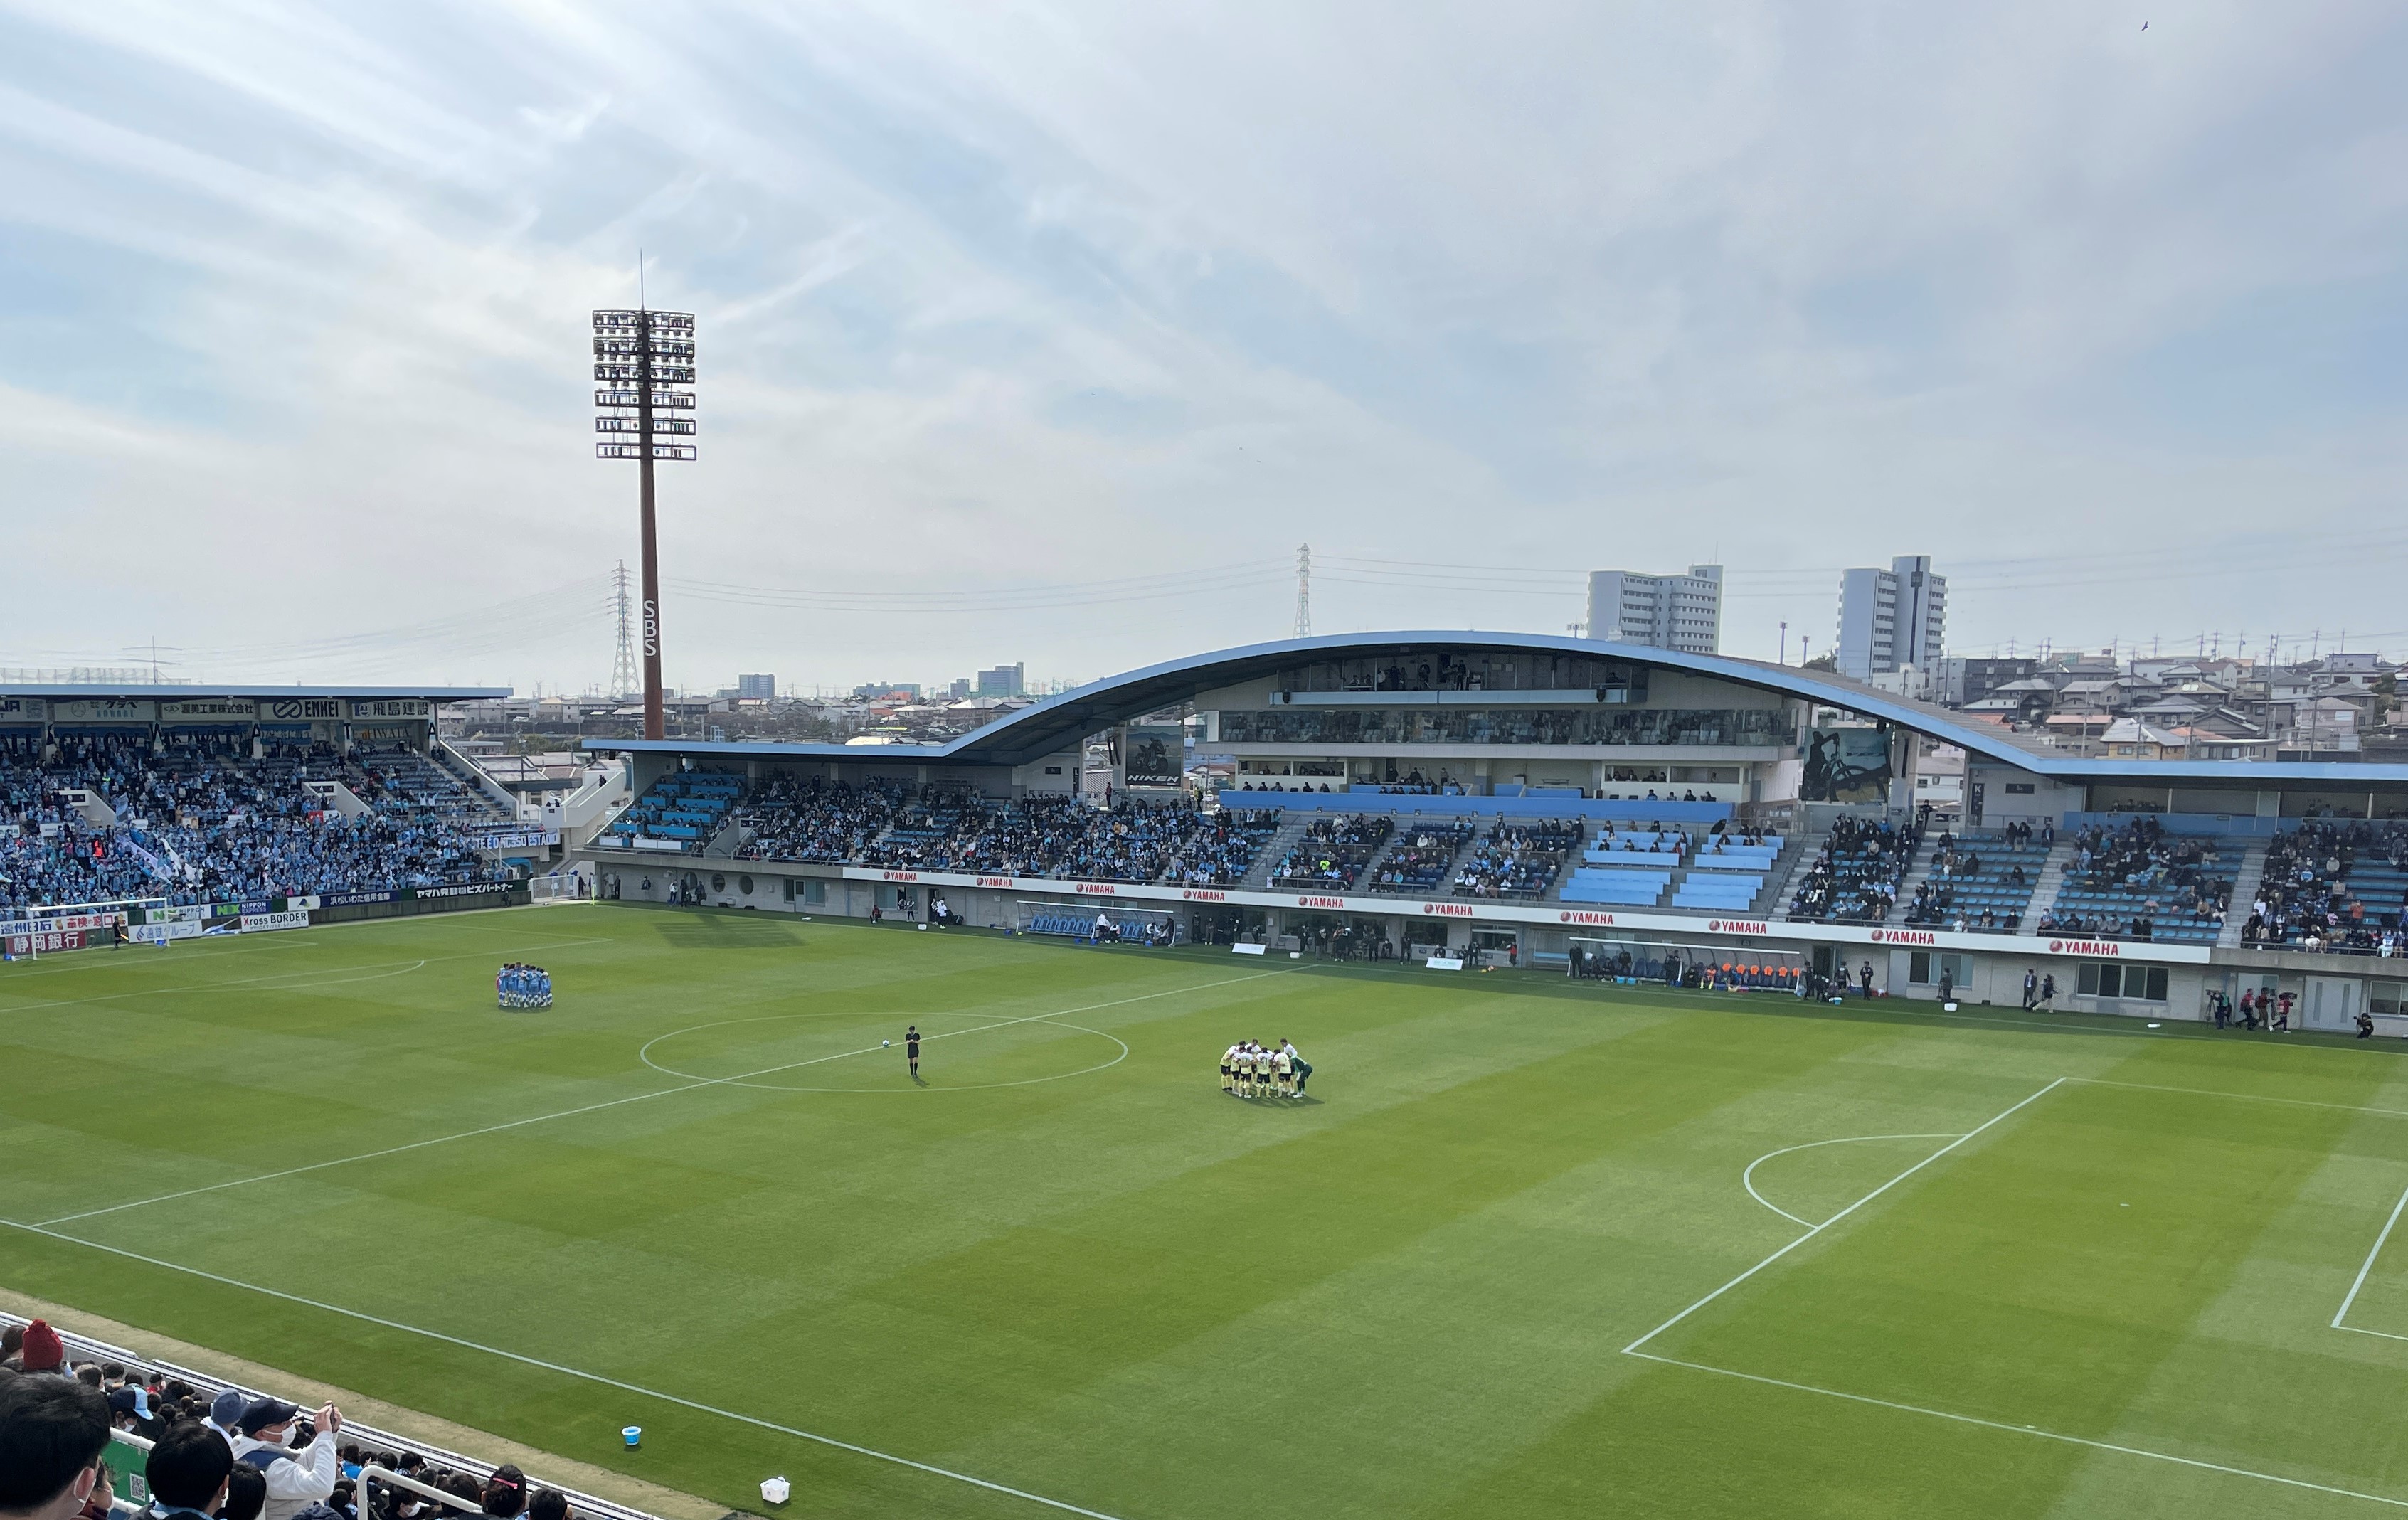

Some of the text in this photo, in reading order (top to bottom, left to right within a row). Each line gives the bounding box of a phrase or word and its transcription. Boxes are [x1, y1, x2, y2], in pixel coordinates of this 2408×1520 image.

[643, 600, 657, 657] SBS
[304, 701, 339, 717] ENKEI
[373, 701, 429, 716] 飛島建設
[891, 872, 917, 881] YAMAHA
[985, 877, 1012, 887] YAMAHA
[1085, 883, 1114, 893] YAMAHA
[1192, 891, 1224, 901] YAMAHA
[1309, 898, 1344, 908] YAMAHA
[216, 904, 240, 916] NX
[1435, 905, 1473, 915] YAMAHA
[243, 912, 307, 926] Xross BORDER
[1573, 913, 1613, 924] YAMAHA
[147, 924, 195, 939] 遠鉄グループ
[1722, 921, 1766, 934] YAMAHA
[14, 932, 79, 953] 静岡銀行
[1886, 930, 1934, 944] YAMAHA
[2065, 941, 2118, 956] YAMAHA
